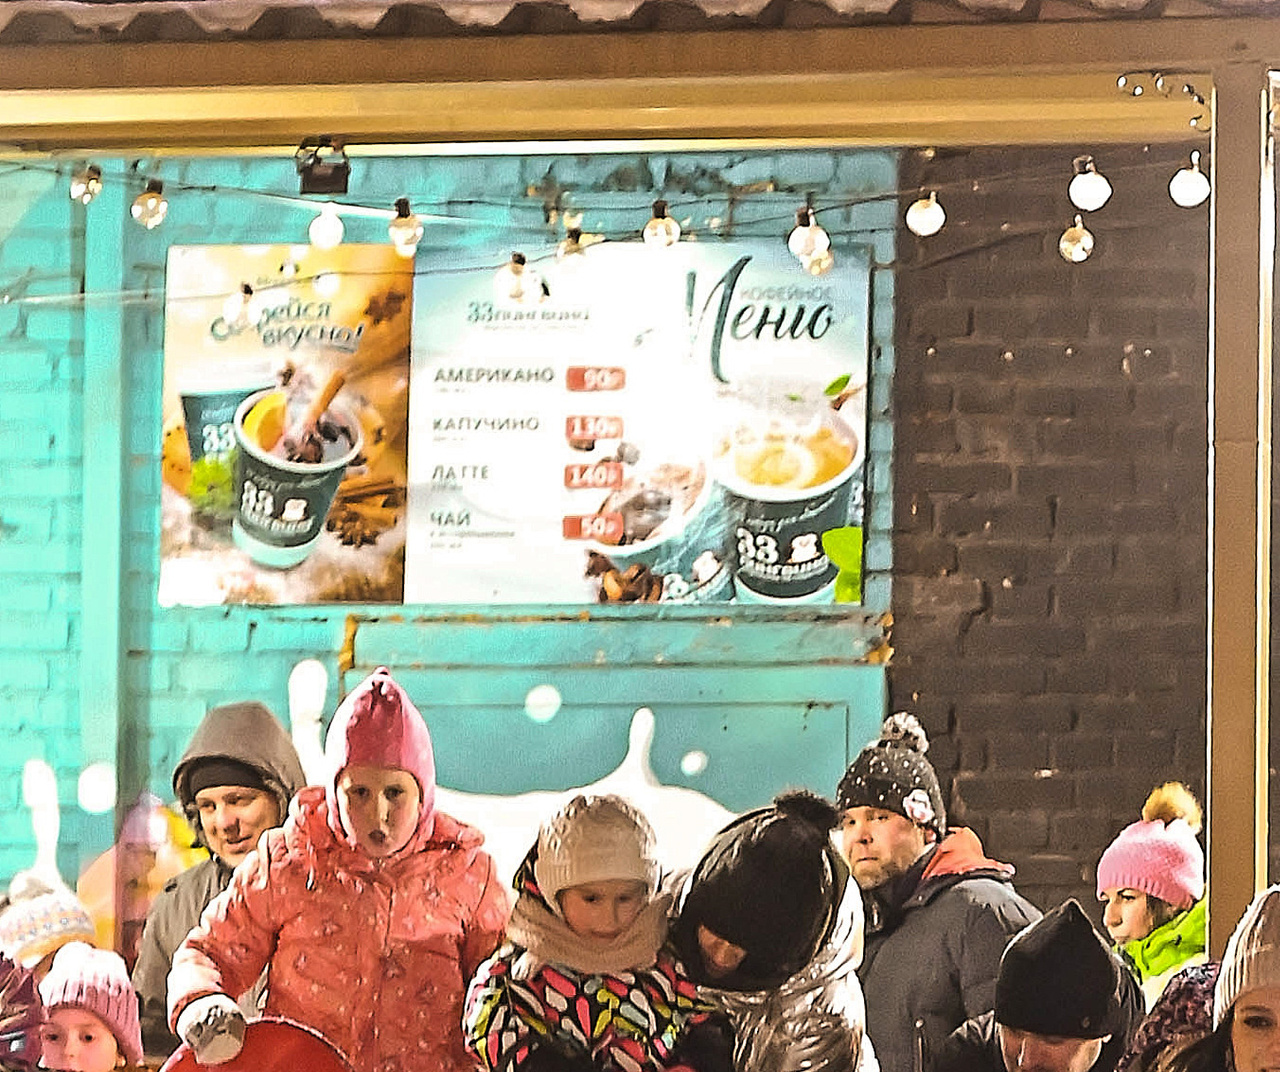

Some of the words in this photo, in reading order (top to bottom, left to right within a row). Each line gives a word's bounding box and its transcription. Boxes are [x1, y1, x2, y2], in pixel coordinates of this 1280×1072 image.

[434, 367, 555, 383] АМЕРИКАНО
[432, 416, 540, 431] КАПУЧИНО
[432, 465, 489, 480] ЛАТТЕ
[430, 508, 471, 526] ЧАЙ
